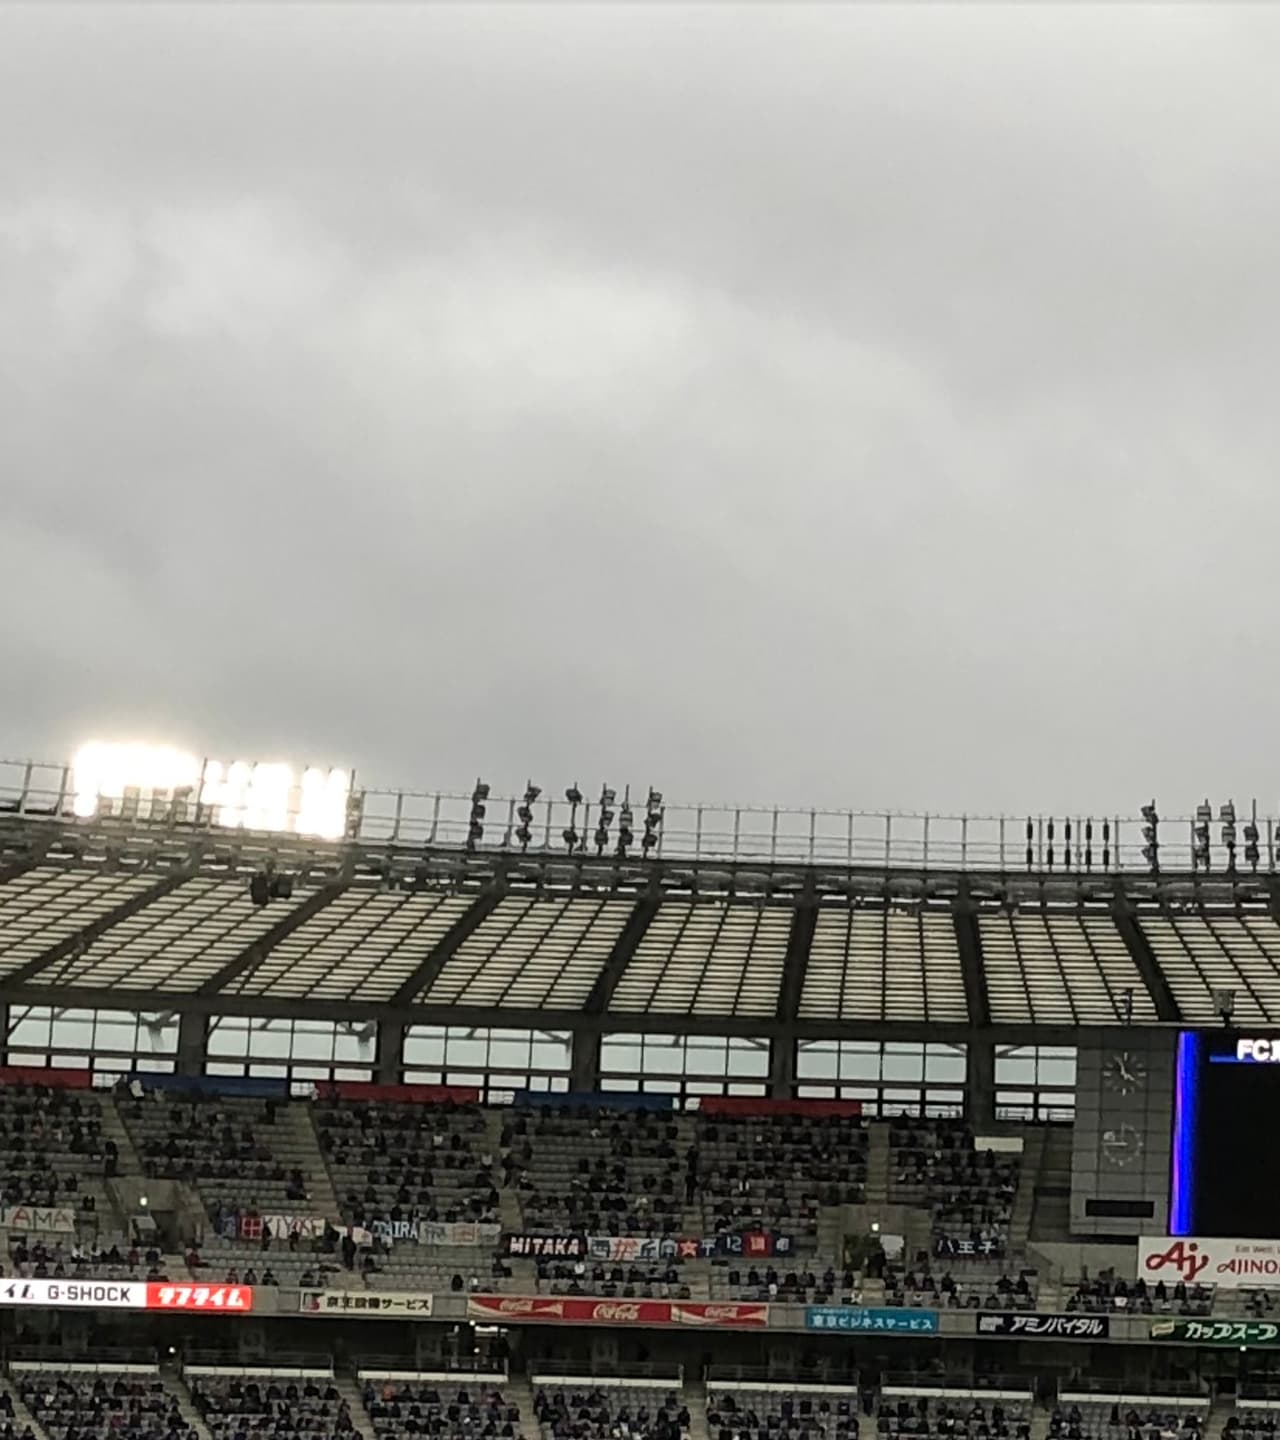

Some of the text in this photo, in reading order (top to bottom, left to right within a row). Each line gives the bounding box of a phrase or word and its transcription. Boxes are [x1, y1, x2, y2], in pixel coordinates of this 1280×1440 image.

[510, 1236, 580, 1255] MITAKA
[937, 1240, 996, 1254] 八王子
[47, 1285, 131, 1303] G-SHOCK
[157, 1286, 244, 1307] タフタイム
[1010, 1316, 1103, 1335] アミノバイタル
[1184, 1321, 1279, 1341] カップスープ
